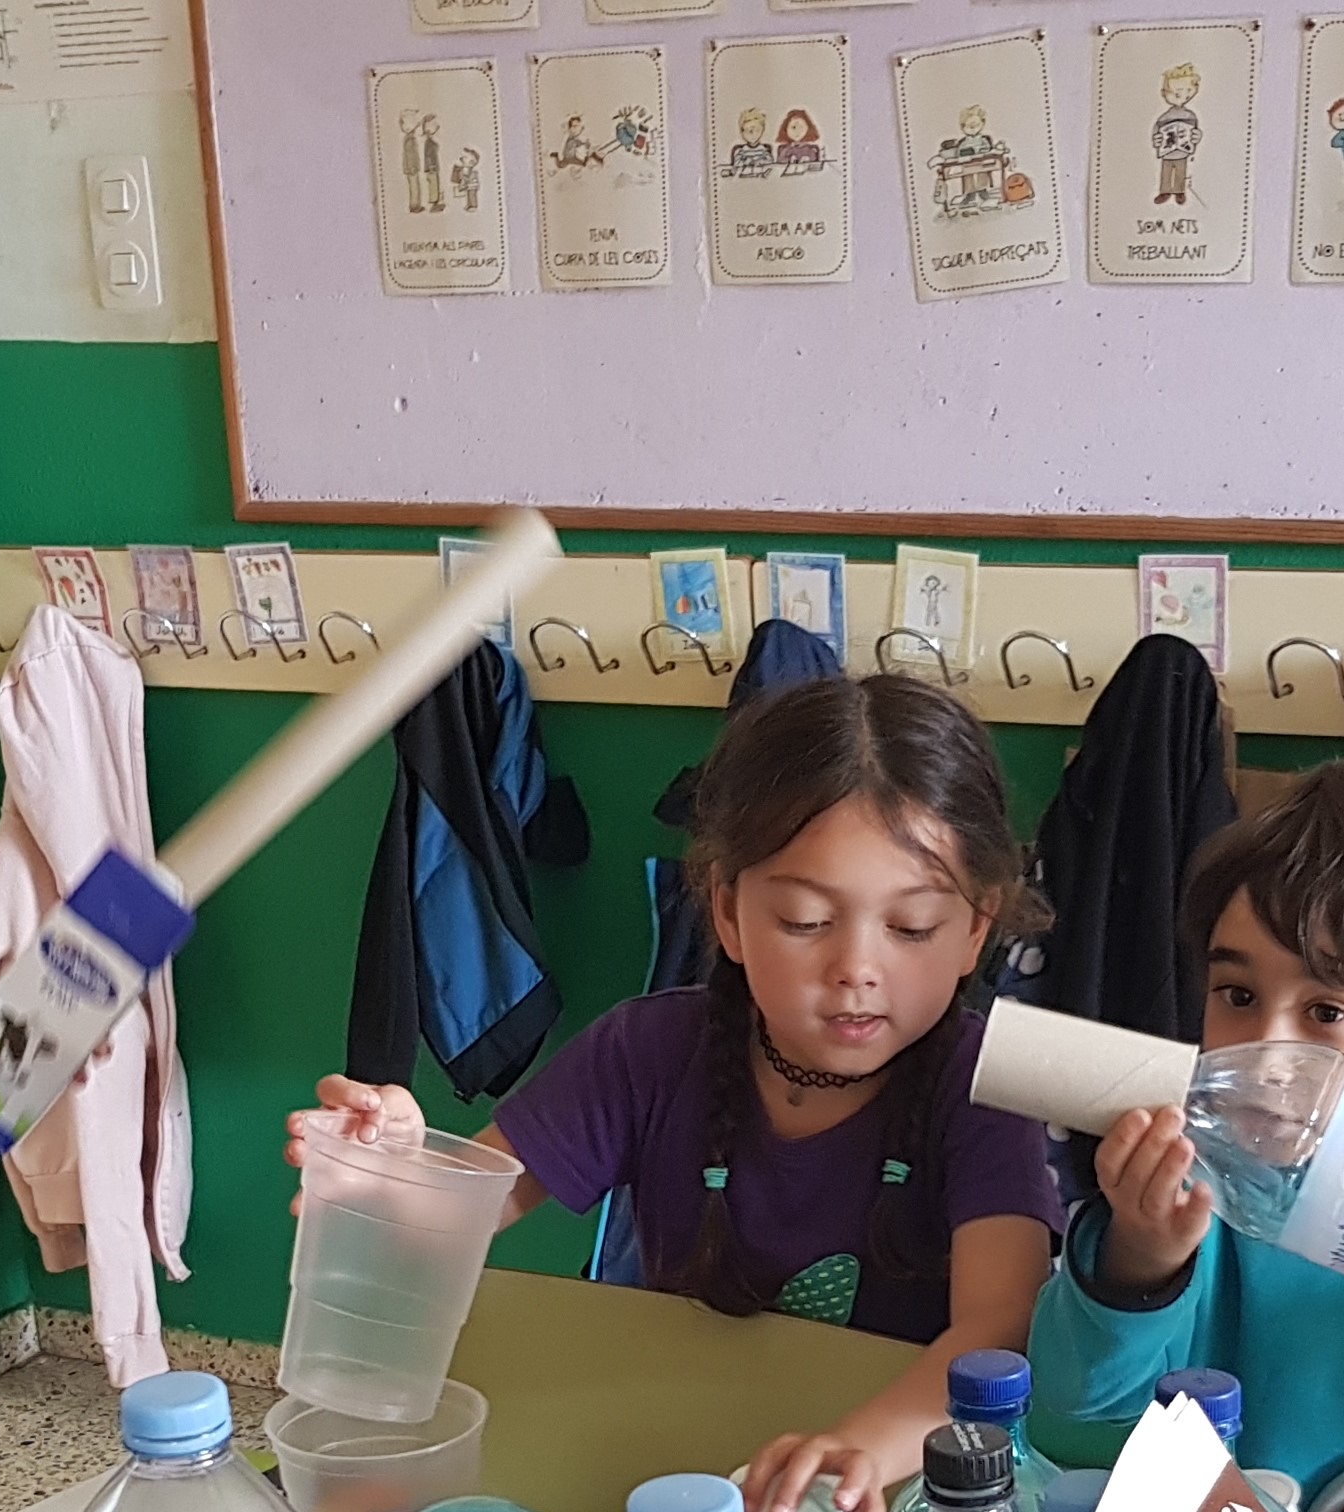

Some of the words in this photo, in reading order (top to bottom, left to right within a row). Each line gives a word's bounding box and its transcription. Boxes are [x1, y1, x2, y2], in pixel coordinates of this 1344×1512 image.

[795, 222, 825, 235] AMB
[1137, 219, 1165, 234] SOM
[1171, 219, 1199, 233] NETS
[1128, 245, 1207, 260] TREBALLANT
[1312, 244, 1335, 258] NO
